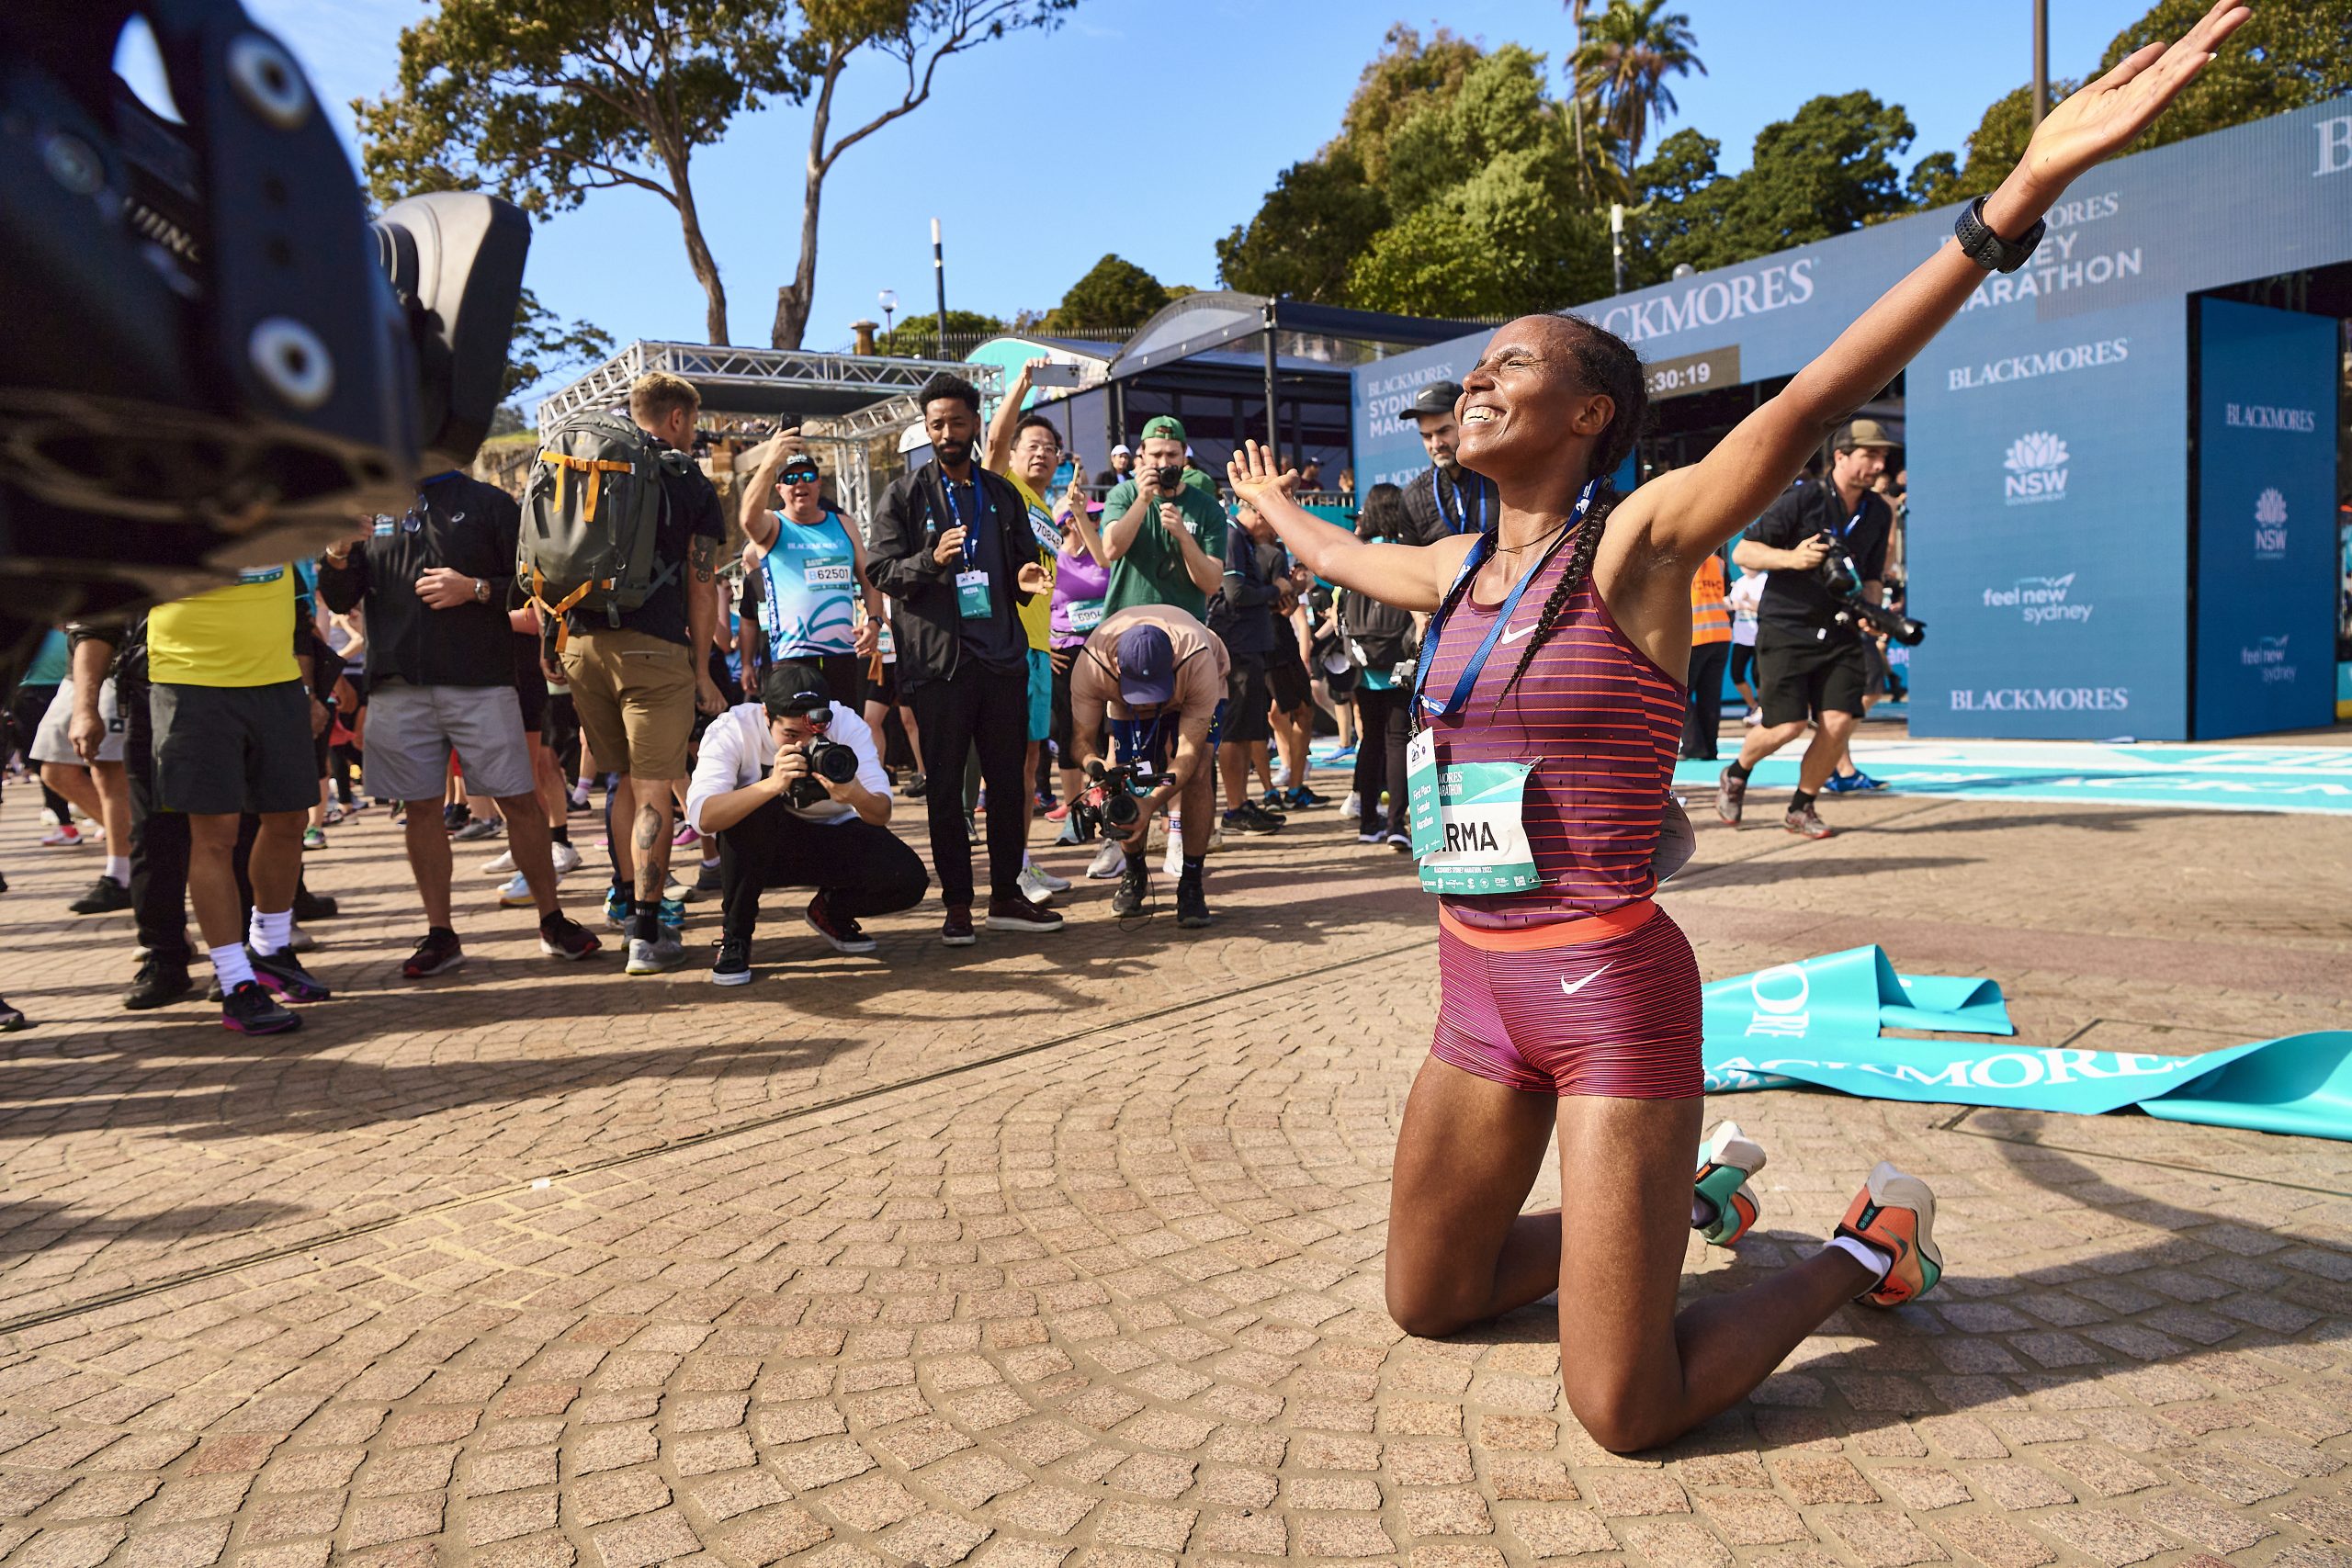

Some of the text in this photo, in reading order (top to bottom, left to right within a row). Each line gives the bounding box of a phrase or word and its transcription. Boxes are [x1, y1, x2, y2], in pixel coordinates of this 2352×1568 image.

[2023, 231, 2078, 268] EY
[1961, 247, 2145, 314] ARATHON
[1594, 258, 1816, 344] CKMORES
[1949, 336, 2130, 391] BLACKMORES
[1368, 363, 1453, 399] BLACKMORES
[2226, 402, 2315, 433] BLACKMORES
[2006, 468, 2069, 499] NSW
[2256, 529, 2288, 551] NSW
[1983, 587, 2067, 606] feel new
[2023, 604, 2093, 626] sydney
[2242, 647, 2285, 665] feel new
[2262, 667, 2297, 684] sydney
[1950, 687, 2129, 711] BLACKMORES
[1435, 821, 1498, 852] RMA
